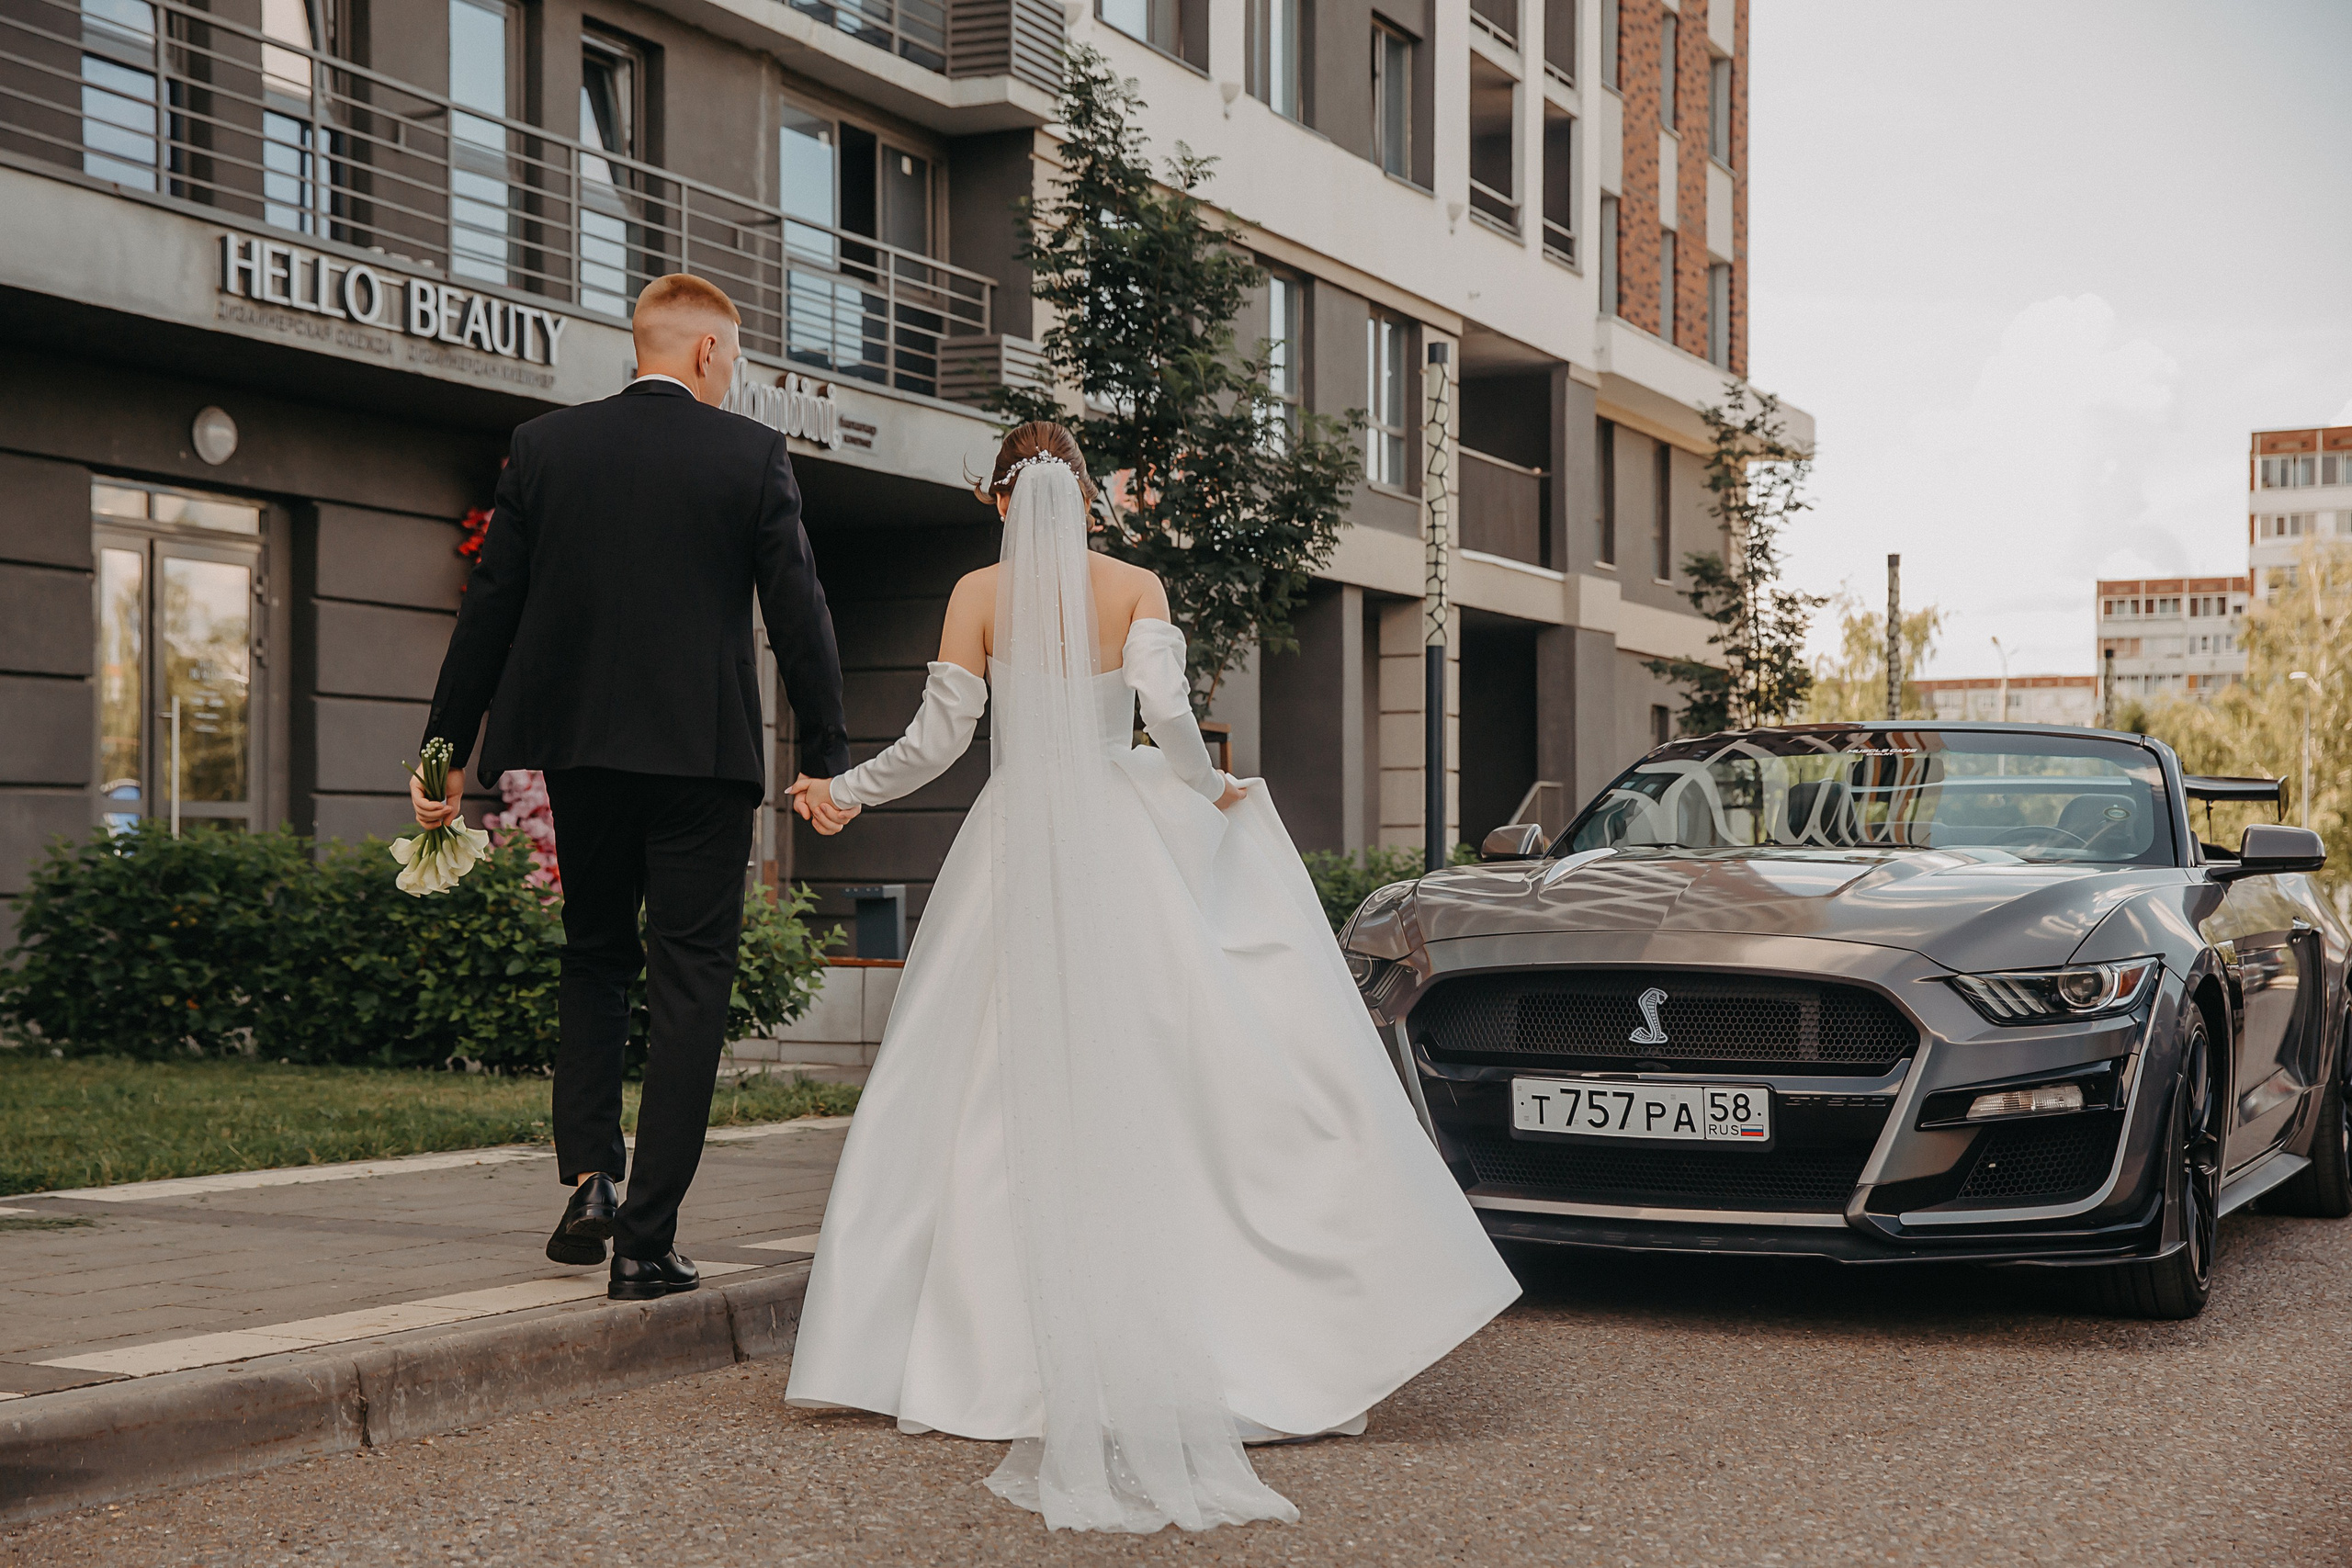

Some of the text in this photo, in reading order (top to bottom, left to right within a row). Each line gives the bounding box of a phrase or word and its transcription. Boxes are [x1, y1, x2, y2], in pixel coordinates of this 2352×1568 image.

[223, 231, 569, 366] HELLO BEAUTY
[1710, 1091, 1752, 1122] 58
[1708, 1123, 1740, 1136] RUS
